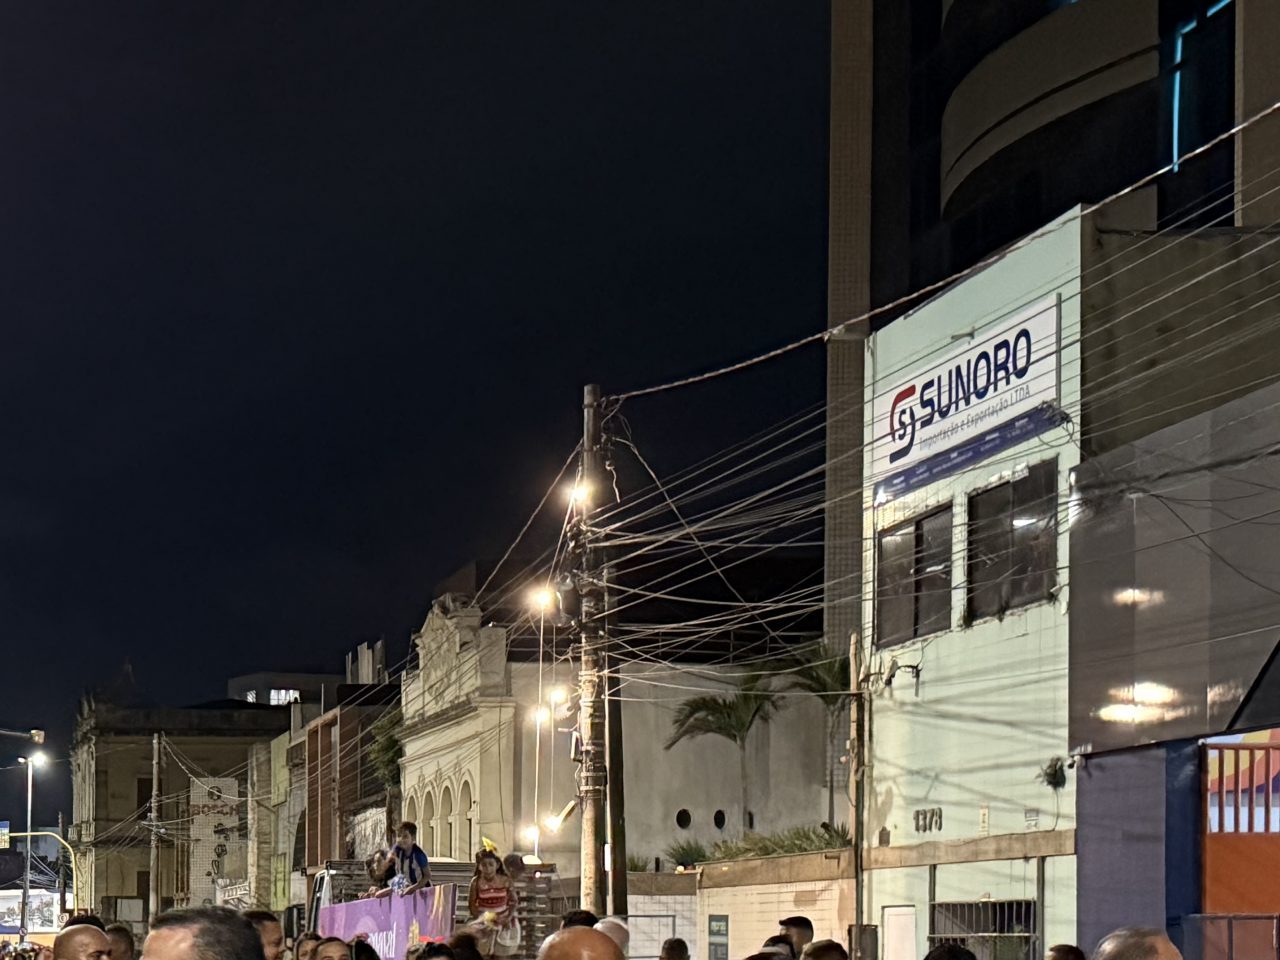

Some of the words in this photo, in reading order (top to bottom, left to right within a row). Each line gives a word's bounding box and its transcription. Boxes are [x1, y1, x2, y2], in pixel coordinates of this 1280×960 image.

[919, 328, 1032, 430] SUNORO
[1010, 385, 1031, 407] LTDA
[913, 807, 943, 832] 1378
